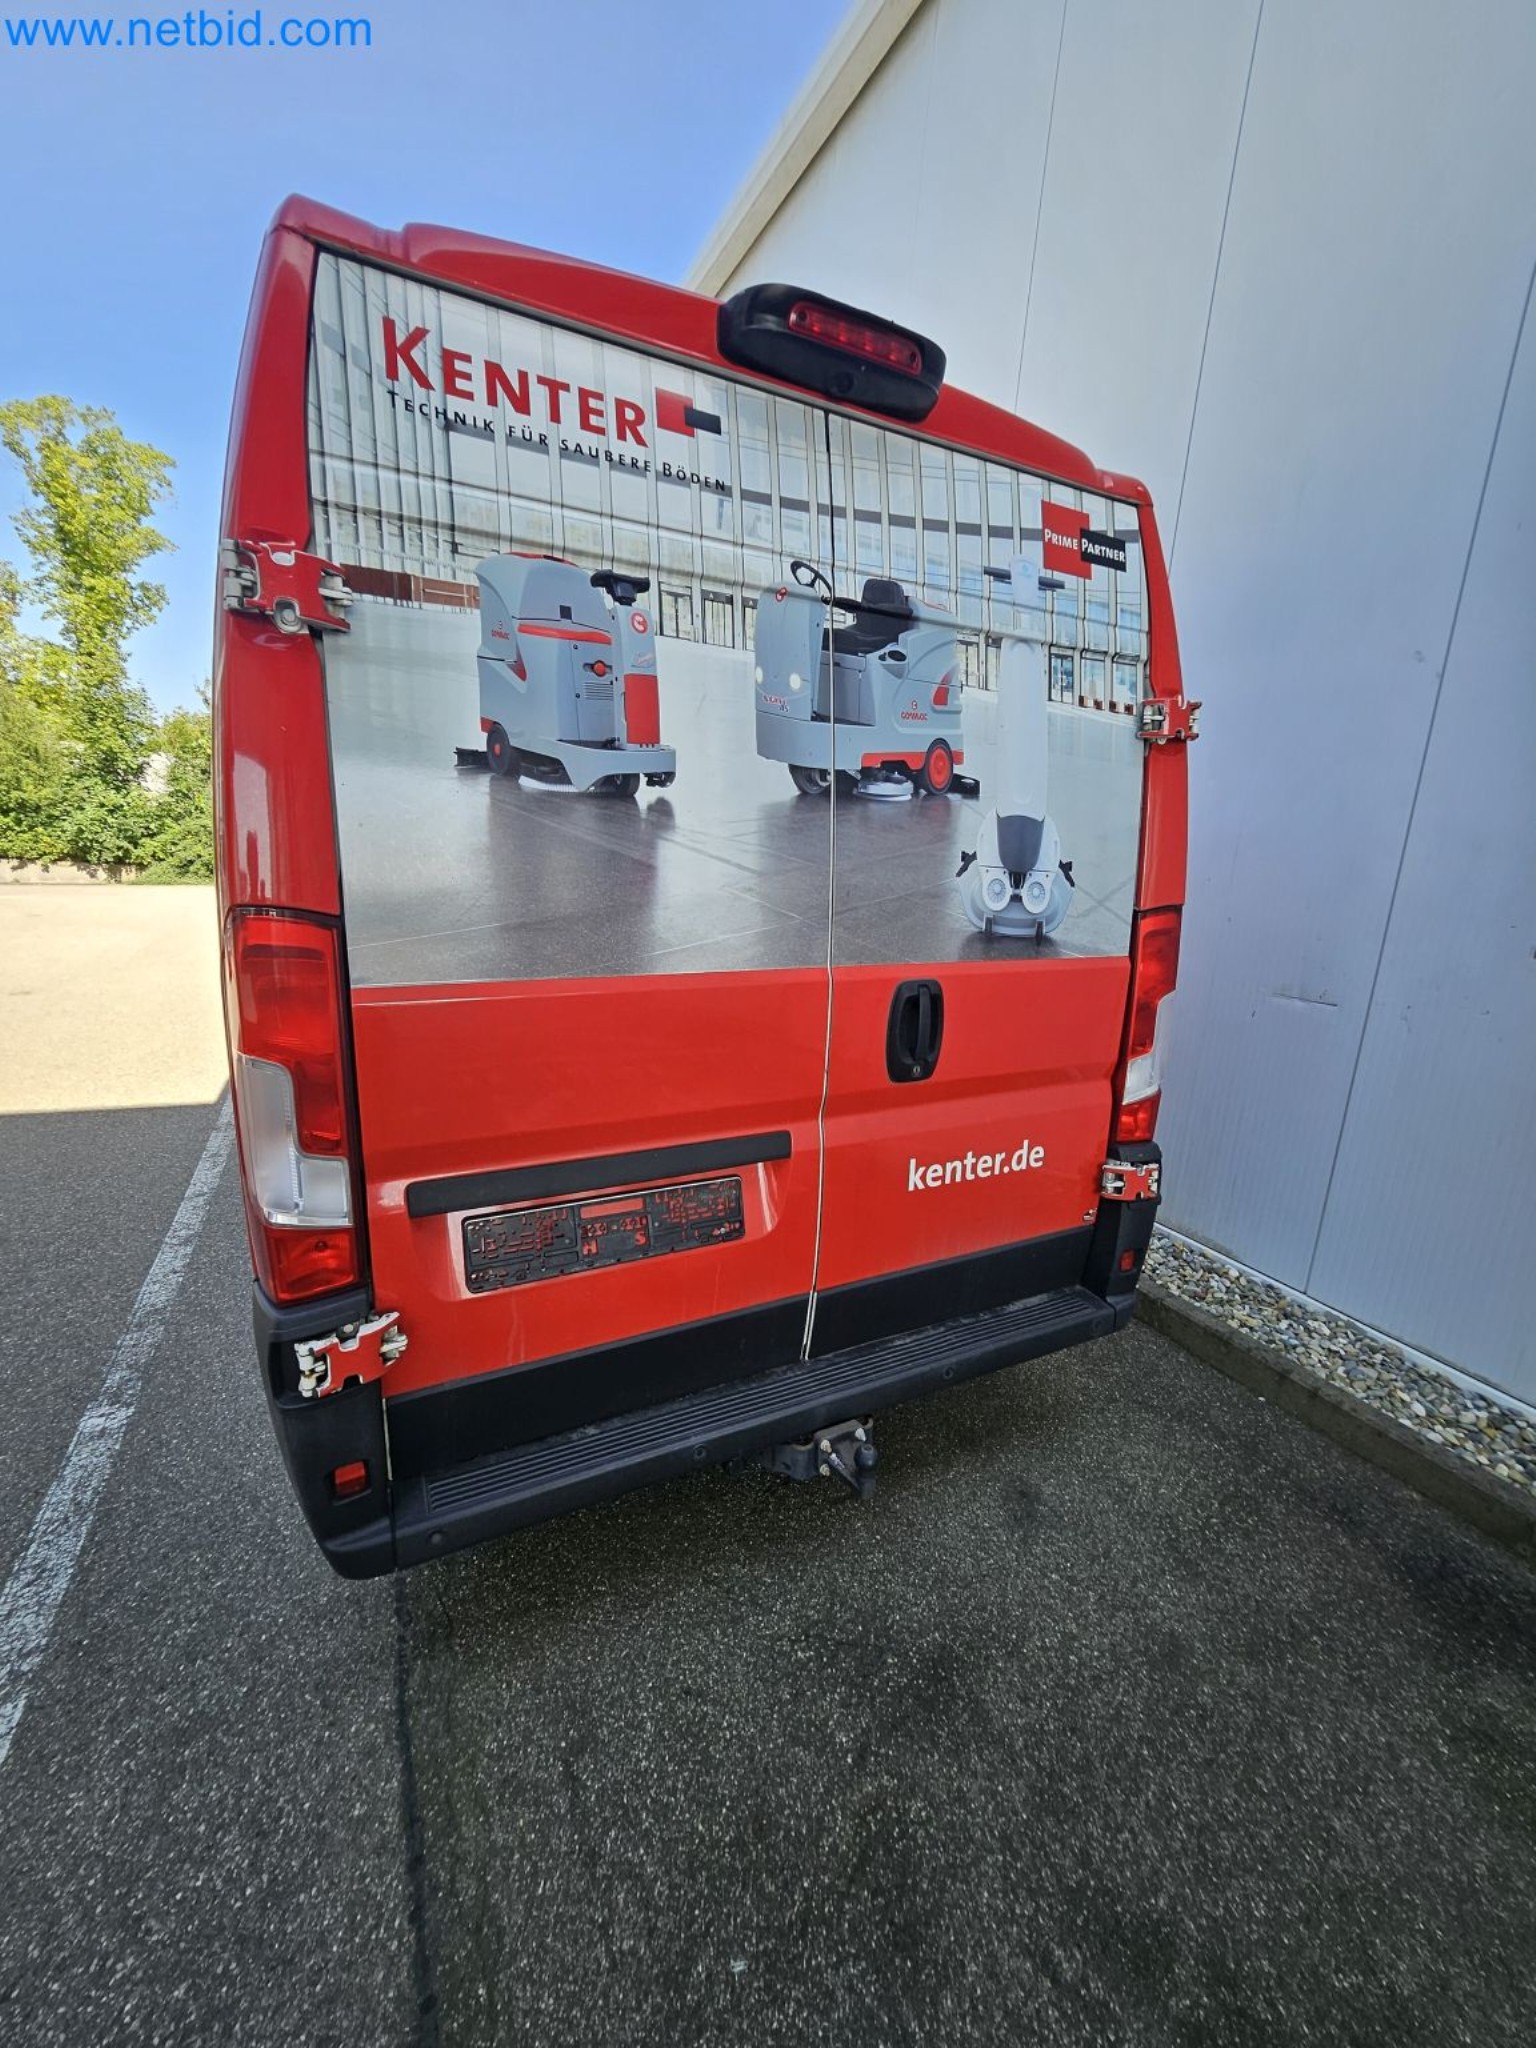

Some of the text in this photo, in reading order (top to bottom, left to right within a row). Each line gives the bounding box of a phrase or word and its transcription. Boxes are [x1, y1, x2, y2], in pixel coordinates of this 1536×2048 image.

[382, 316, 649, 448] KENTER
[387, 390, 725, 492] TECHNIK FÜR SAUBERE BÖDEN
[1044, 528, 1125, 562] PRIME PARTNER
[908, 1139, 1045, 1192] kenter.de
